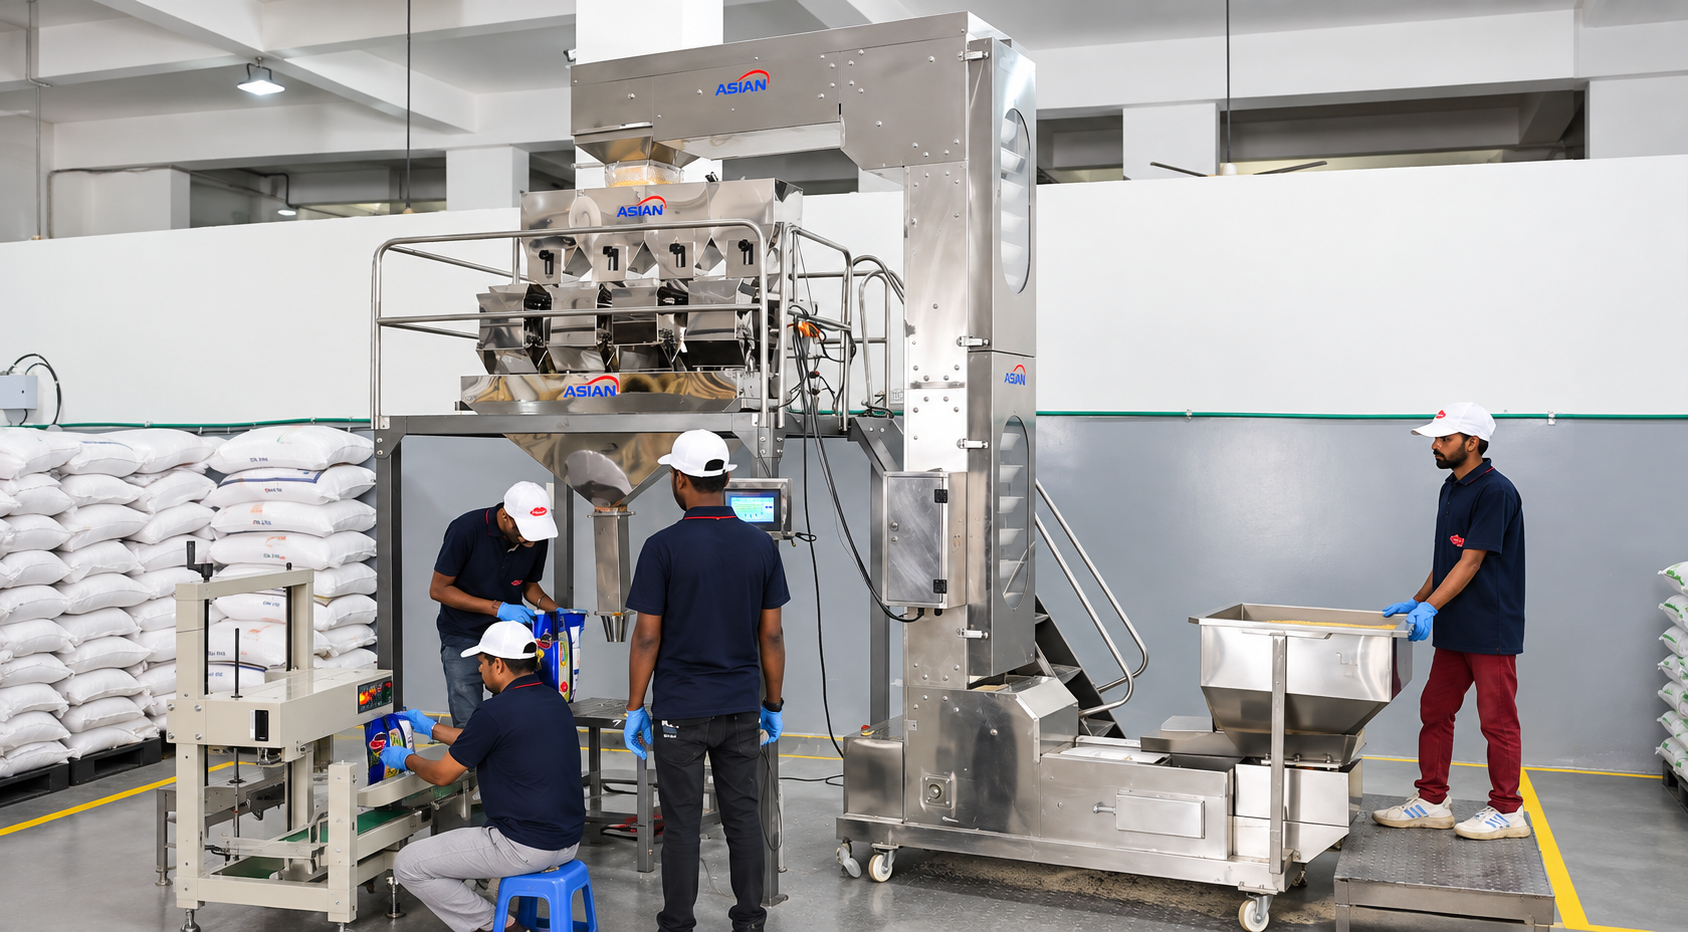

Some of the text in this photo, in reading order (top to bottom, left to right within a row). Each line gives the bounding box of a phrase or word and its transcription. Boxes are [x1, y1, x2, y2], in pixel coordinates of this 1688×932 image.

[715, 79, 767, 96] ASIAN
[616, 204, 664, 218] ASIAN
[563, 385, 617, 398] ASIAN
